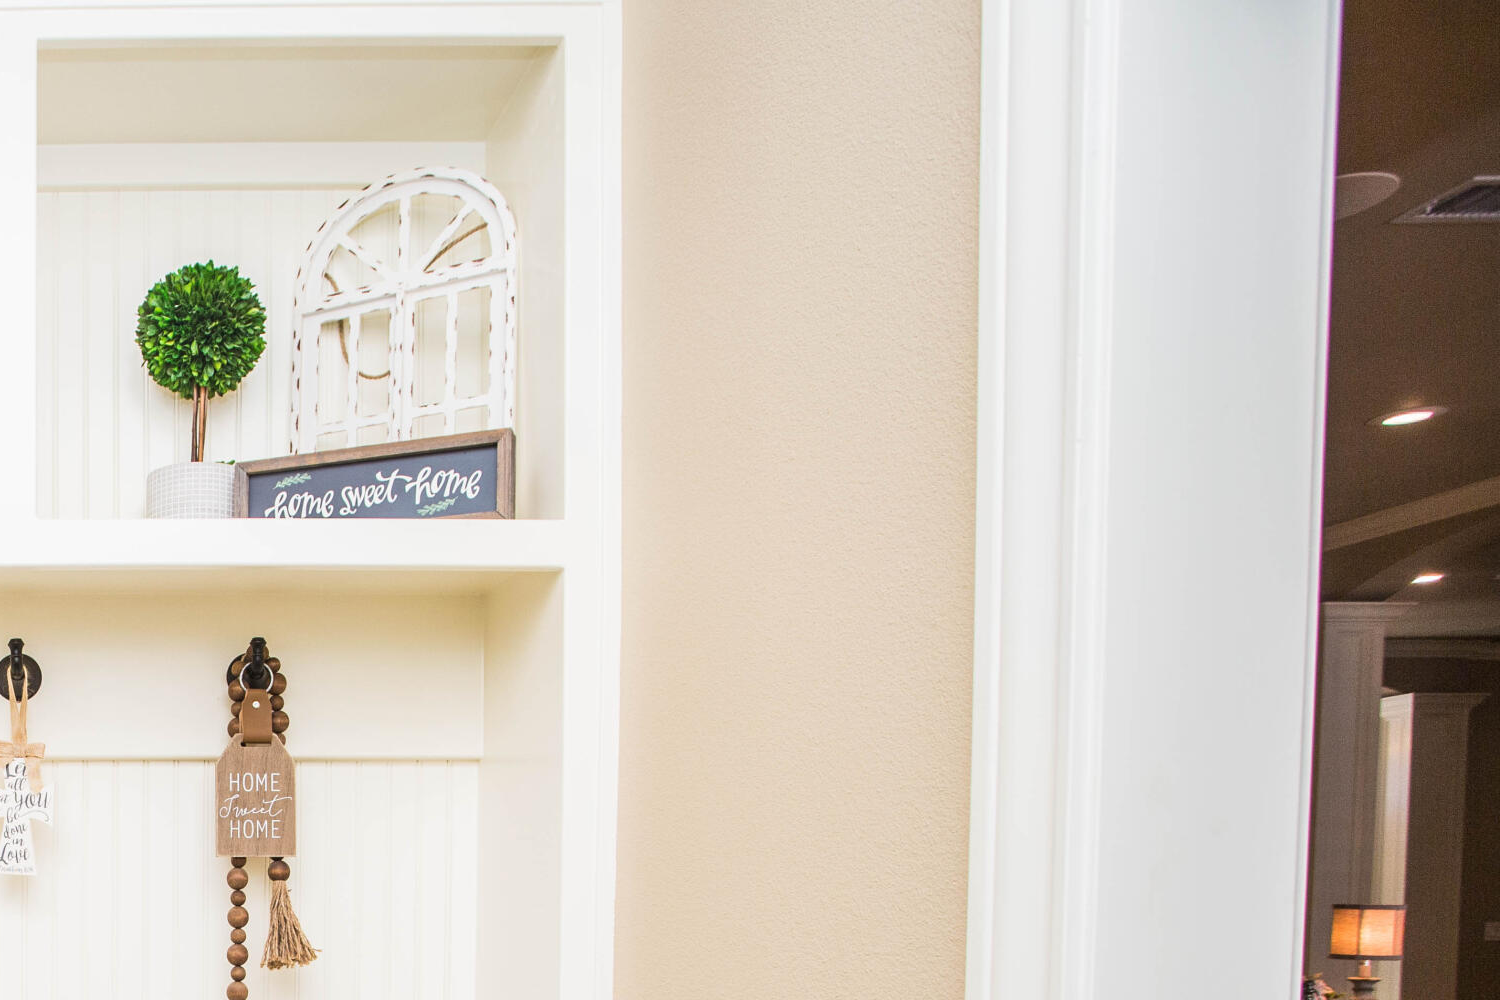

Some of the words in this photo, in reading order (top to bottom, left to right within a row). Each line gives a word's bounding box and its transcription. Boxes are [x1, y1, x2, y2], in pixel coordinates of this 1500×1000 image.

[264, 488, 334, 519] home
[339, 468, 413, 516] sweet
[404, 465, 483, 506] home
[229, 772, 281, 793] HOME
[219, 793, 293, 819] Sweet
[229, 819, 281, 839] HOME
